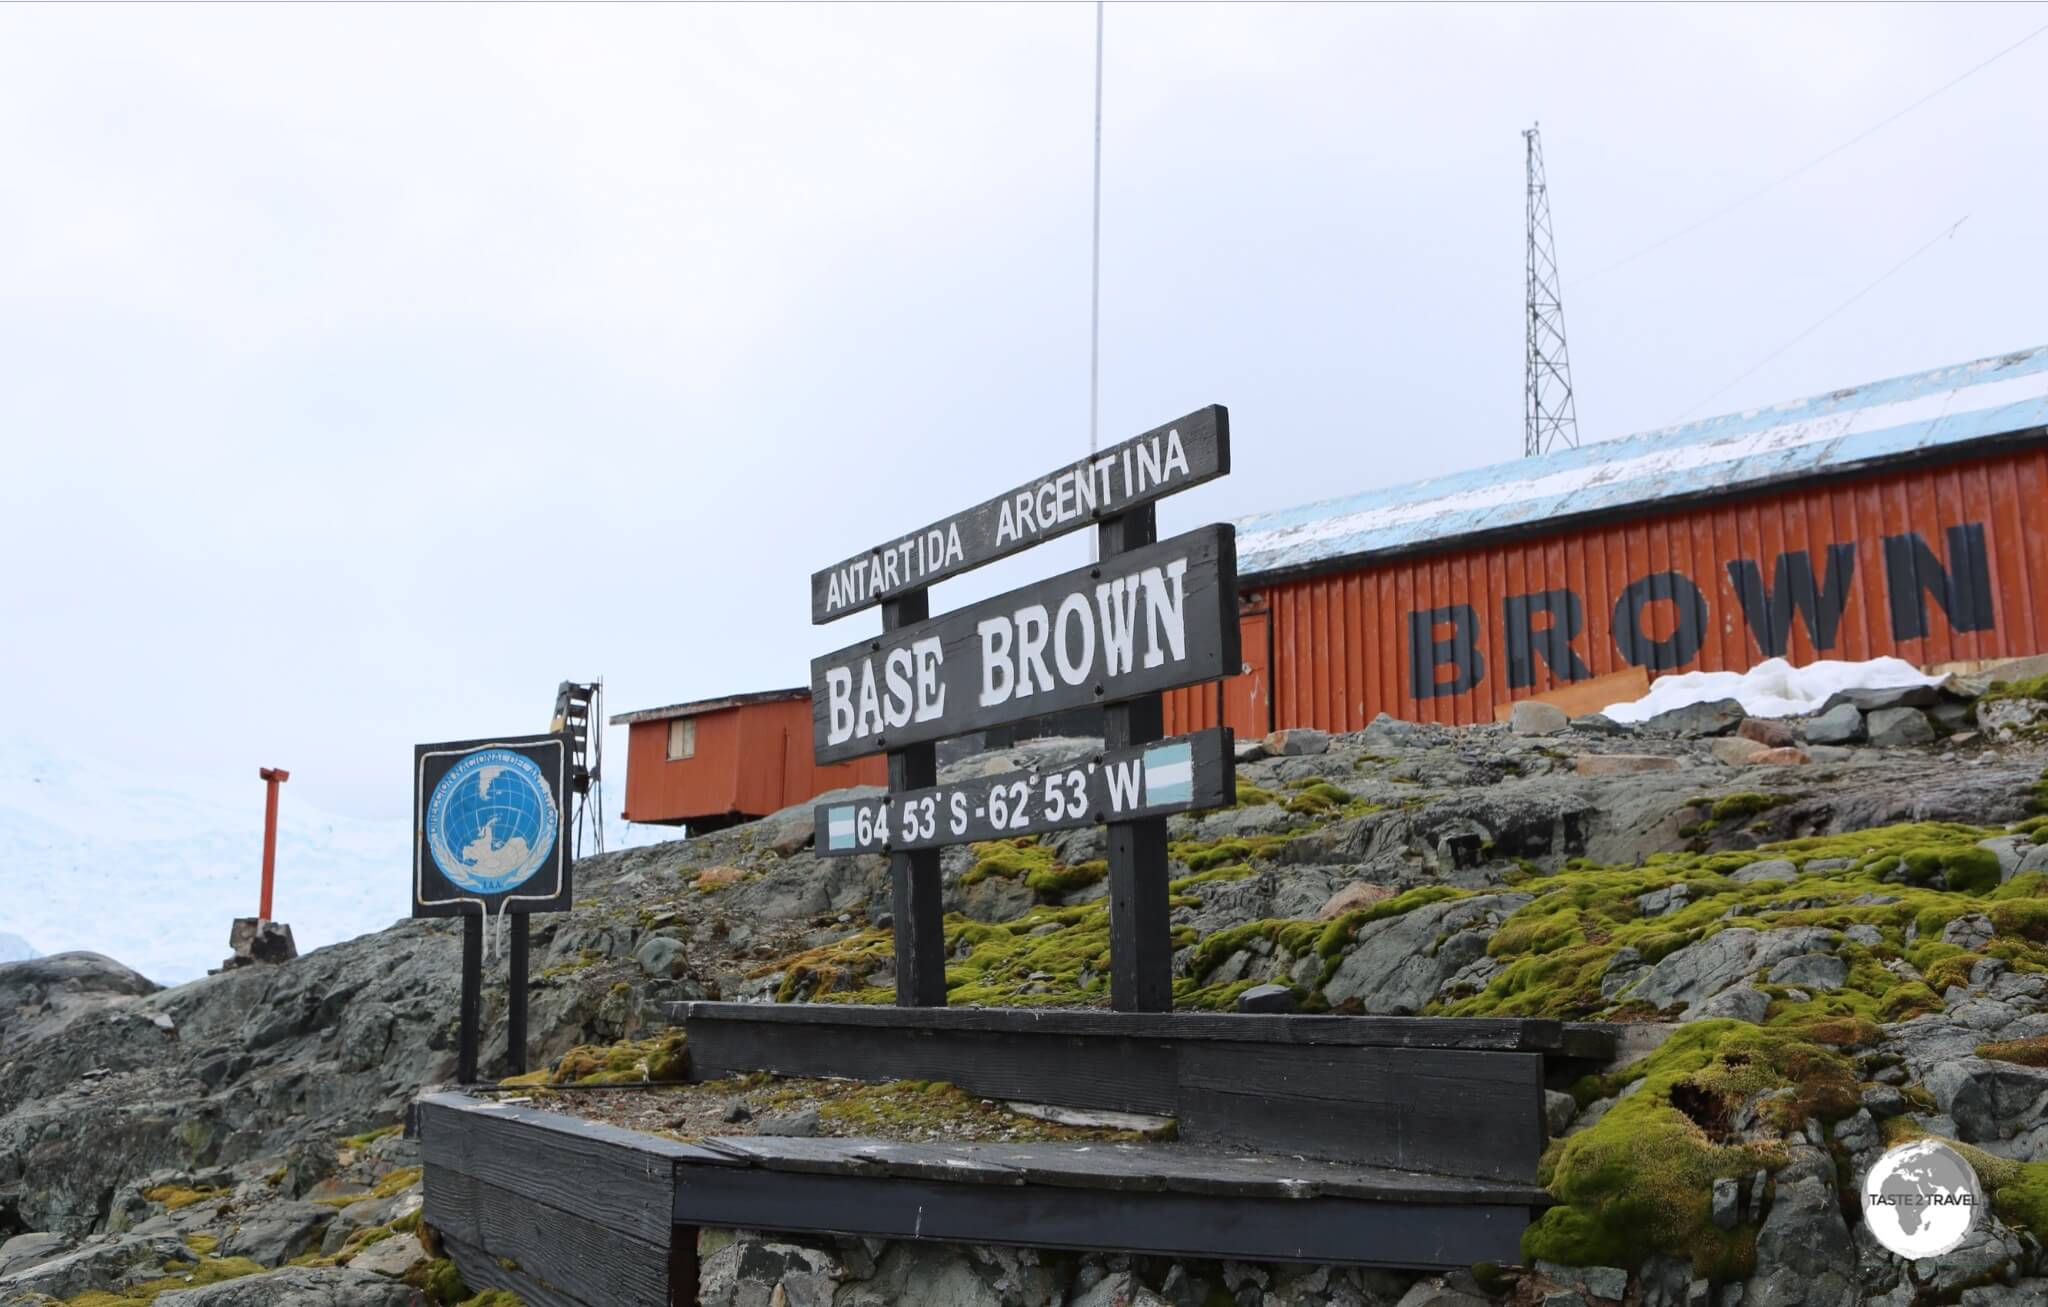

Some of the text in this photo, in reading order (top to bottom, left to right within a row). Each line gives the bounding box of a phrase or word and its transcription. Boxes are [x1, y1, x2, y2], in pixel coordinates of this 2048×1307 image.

[826, 429, 1189, 612] ANTARTIDA ARGENTINA
[826, 557, 1188, 746] BASE BROWN
[1407, 522, 1995, 700] BROWN
[1104, 758, 1141, 812] W
